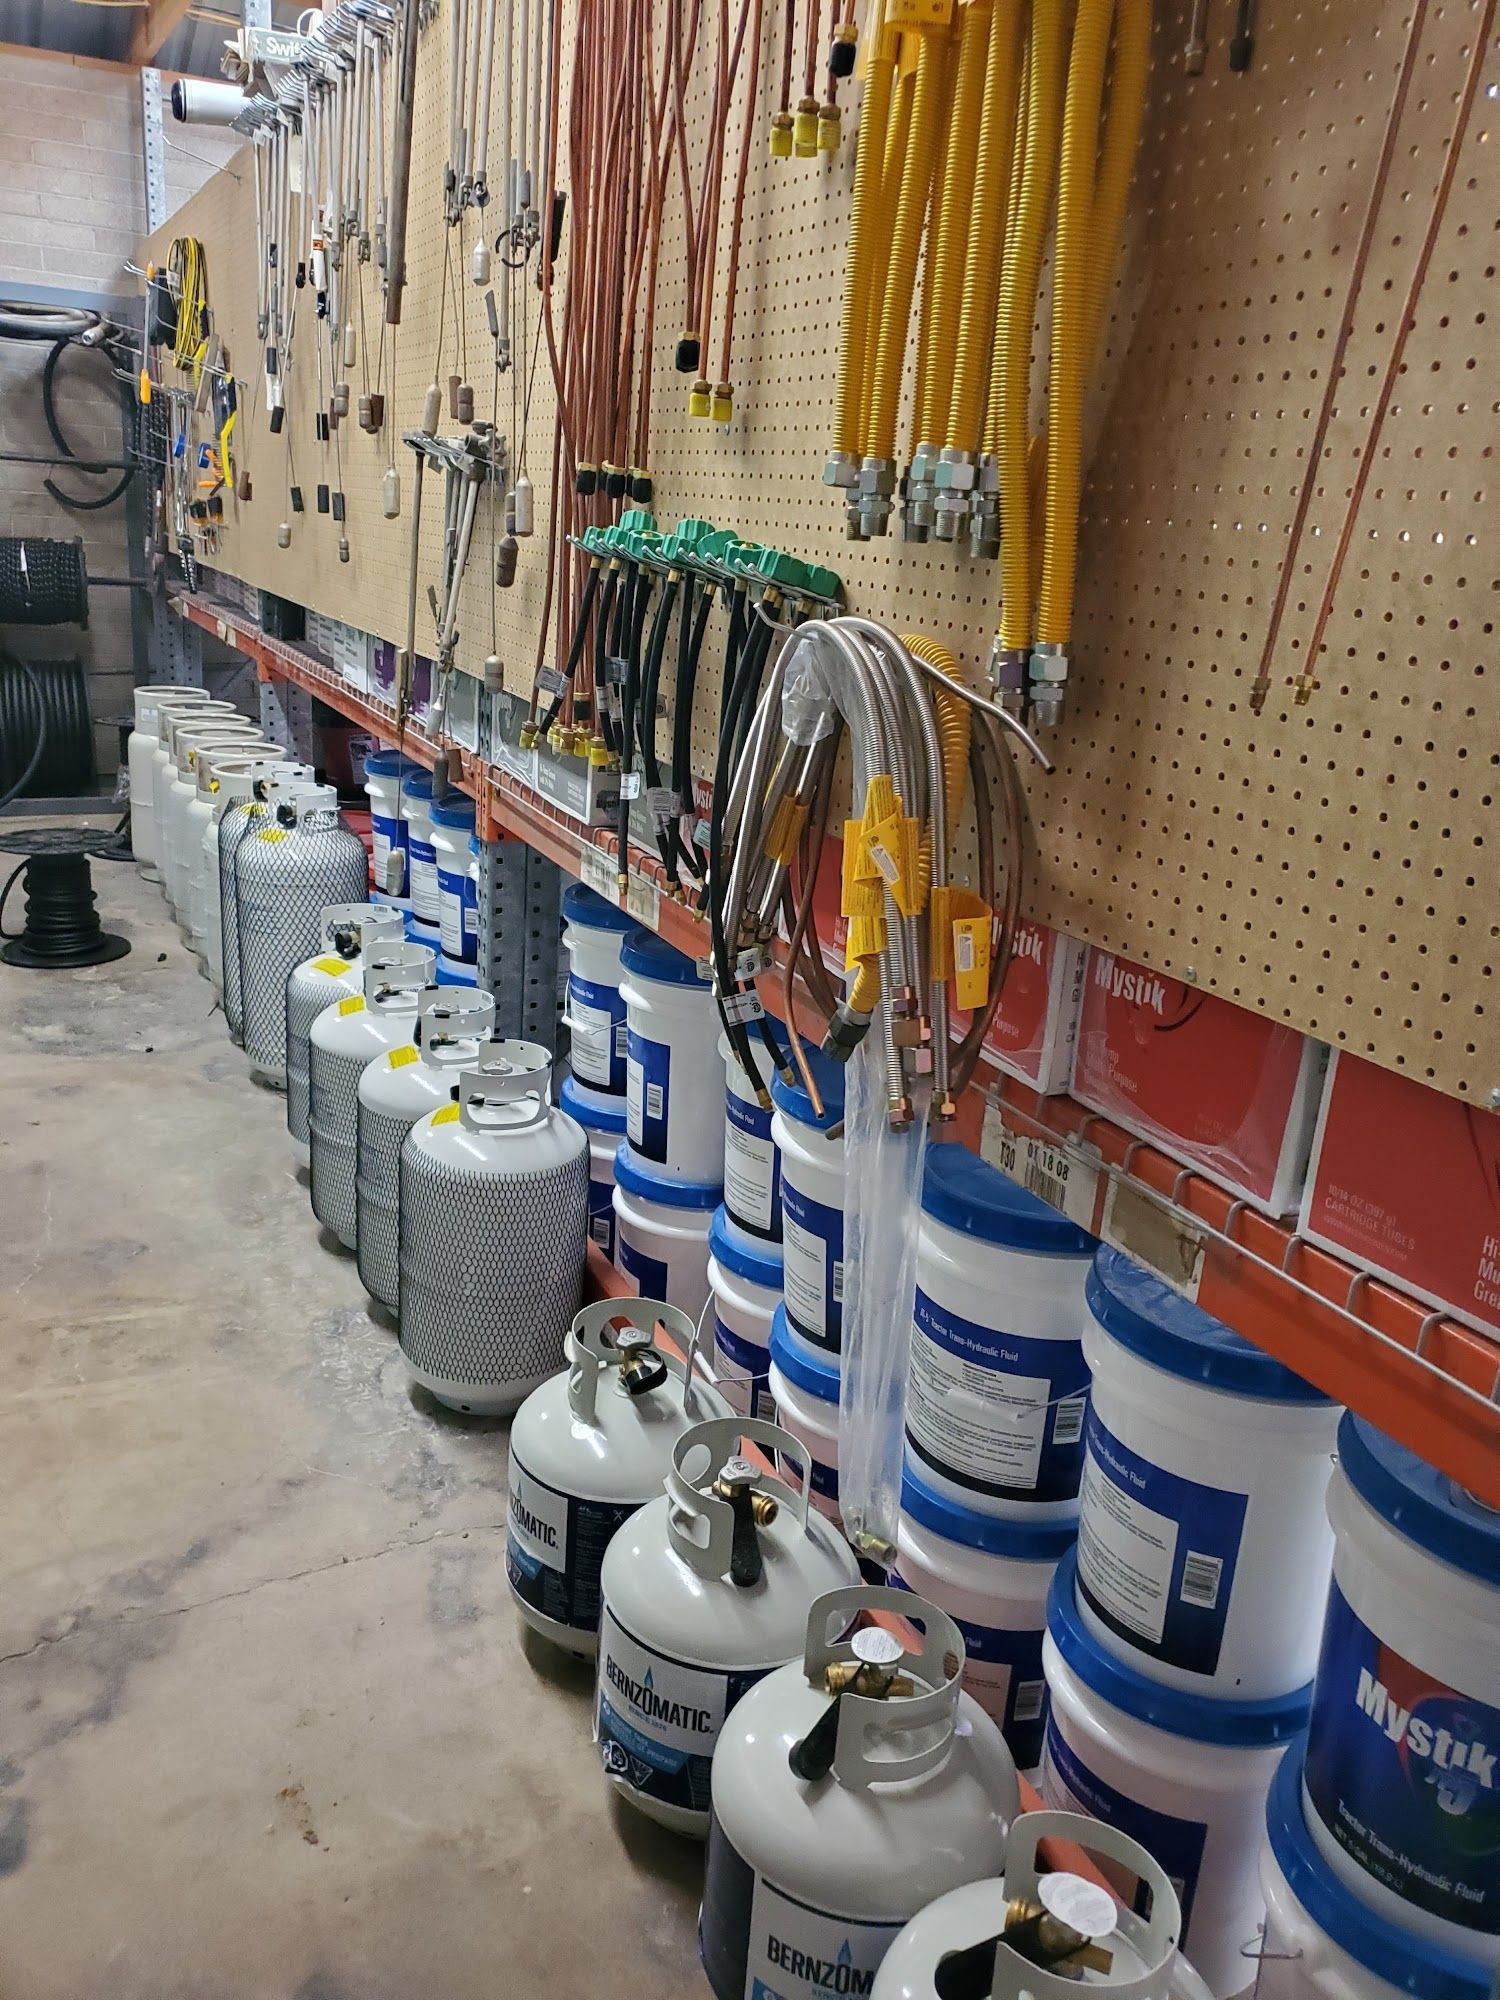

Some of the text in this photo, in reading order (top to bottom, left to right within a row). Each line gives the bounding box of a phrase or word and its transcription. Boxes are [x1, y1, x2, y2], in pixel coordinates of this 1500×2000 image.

[1095, 952, 1166, 1016] Mystik
[1000, 1141, 1015, 1171] T30
[1043, 1150, 1053, 1171] 18
[1057, 1161, 1069, 1181] 08
[1325, 1196, 1378, 1233] CARTRIDGE
[1382, 1224, 1416, 1250] TUBES
[949, 1329, 999, 1358] Trans-Hydraulic
[1000, 1348, 1019, 1363] Fluid
[510, 1494, 559, 1549] ZOMATIC
[606, 1653, 714, 1735] BERNZOMATIC
[1356, 1665, 1498, 1789] Mystik
[1368, 1828, 1451, 1891] Trans-Hydraulic
[1454, 1882, 1485, 1904] Fluid
